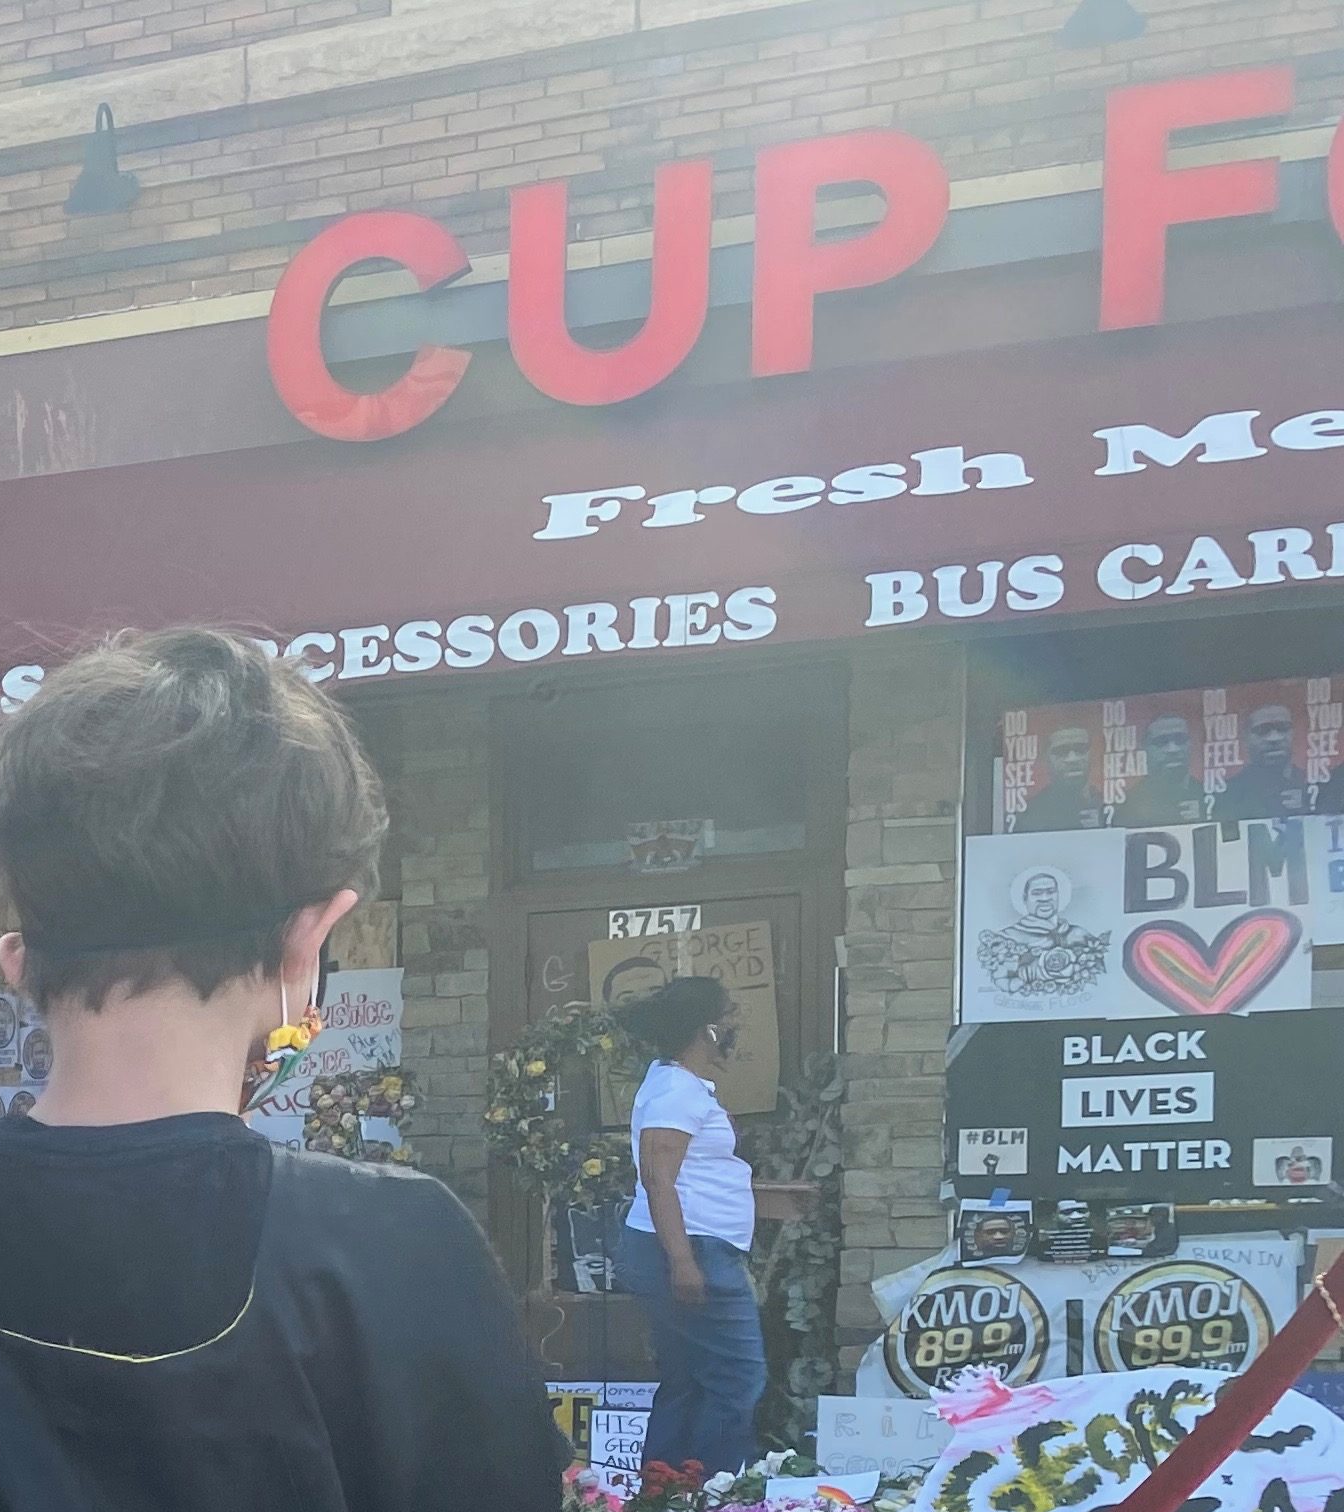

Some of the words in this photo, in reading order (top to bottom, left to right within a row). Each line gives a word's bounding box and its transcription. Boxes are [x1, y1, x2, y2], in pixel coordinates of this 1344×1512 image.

[267, 130, 950, 442] CUP
[1099, 65, 1344, 331] F
[530, 445, 1035, 542] Fresh
[252, 586, 777, 685] CESSORIES
[864, 555, 1064, 629] BUS
[1097, 522, 1344, 601] CAR
[1005, 711, 1028, 737] DO
[1103, 726, 1138, 753] YOU
[1005, 735, 1039, 762] YOU
[1103, 750, 1149, 778] HEAR
[1203, 740, 1244, 768] FEEL
[1005, 762, 1035, 787] SEE
[1203, 767, 1227, 794] US
[1307, 757, 1331, 784] US
[1005, 788, 1028, 813] US
[1103, 779, 1126, 804] US
[1124, 818, 1310, 914] BLM
[612, 907, 698, 940] 3757
[640, 928, 761, 962] GEORGE
[1063, 1031, 1207, 1066] BLACK
[1080, 1086, 1198, 1118] LIVES
[966, 1129, 1026, 1147] #BLM
[1057, 1139, 1233, 1174] MATTER
[900, 1283, 1021, 1332] KMOJ
[1111, 1280, 1242, 1331] KMOJ
[914, 1321, 1011, 1369] 89.9
[1130, 1318, 1231, 1366] 89.9
[605, 1437, 645, 1455] GEO
